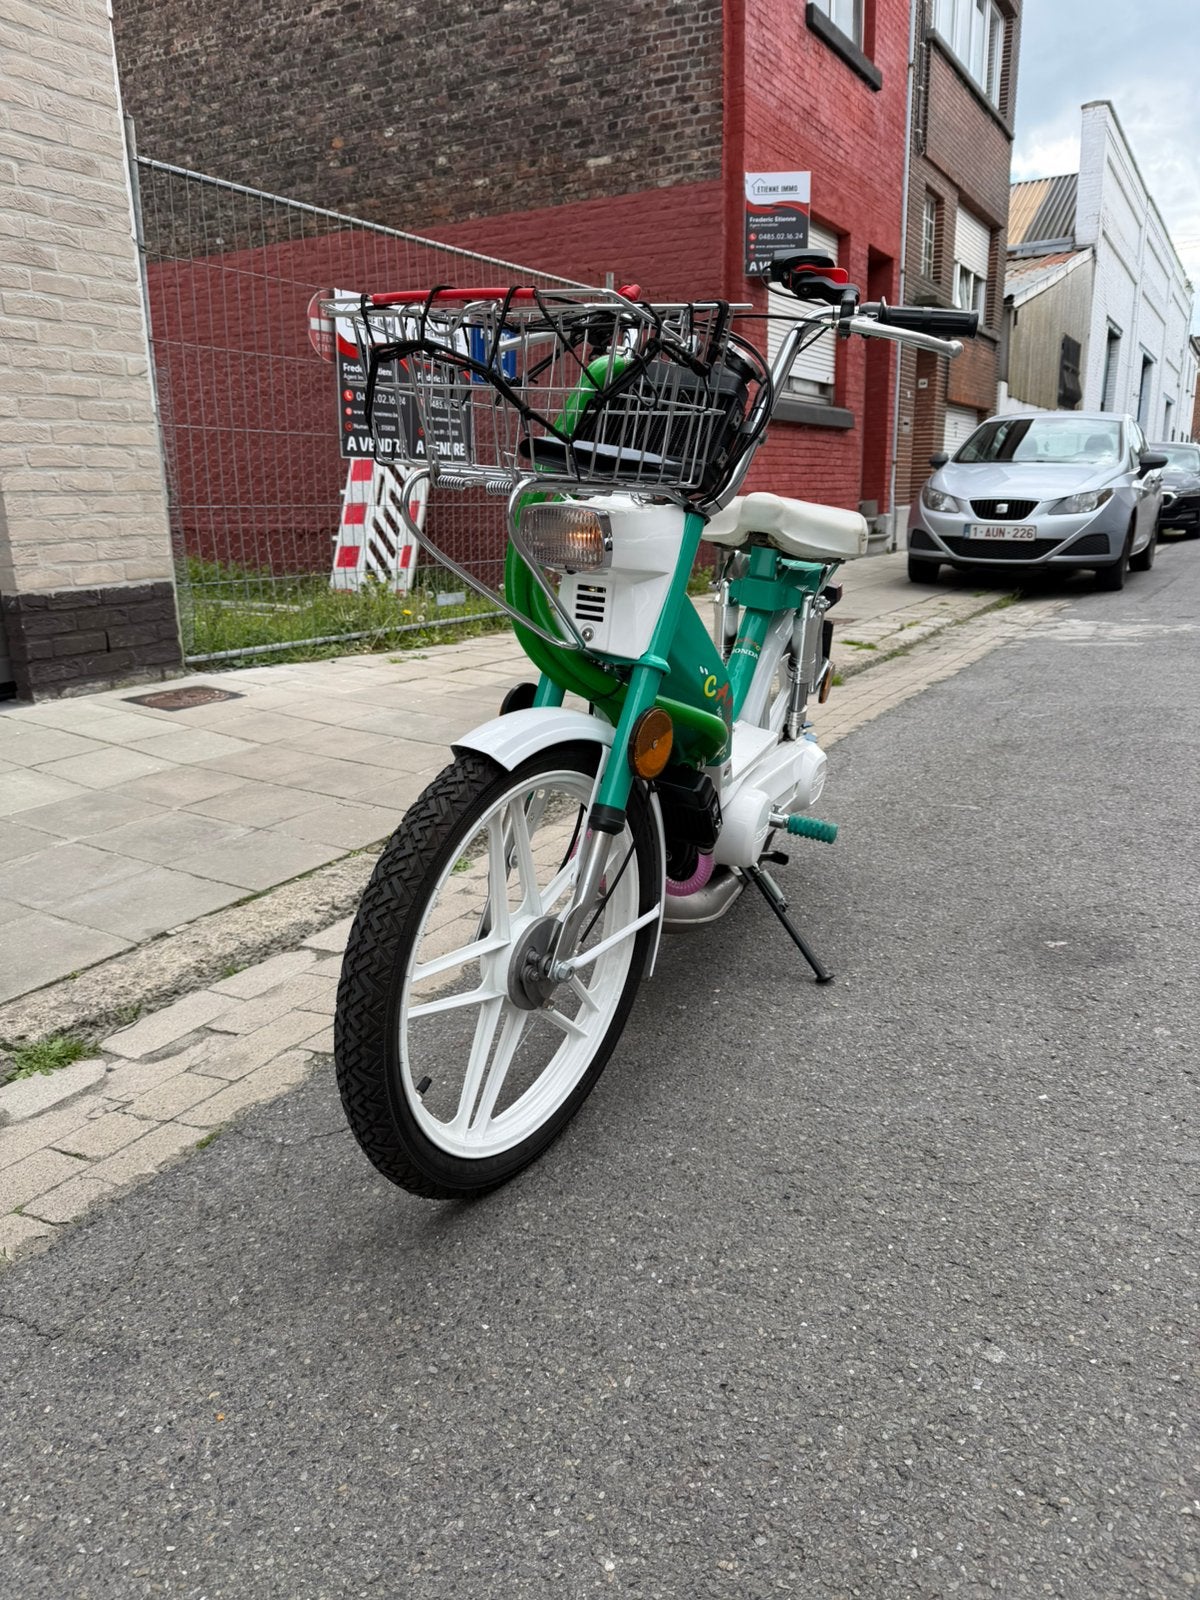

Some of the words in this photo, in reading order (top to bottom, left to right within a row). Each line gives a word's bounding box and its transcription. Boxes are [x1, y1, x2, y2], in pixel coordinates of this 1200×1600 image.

[758, 232, 804, 240] 0485.02.16.24
[749, 261, 758, 272] A
[346, 435, 358, 452] A
[358, 436, 406, 454] VENDR
[415, 439, 425, 455] A
[435, 441, 466, 457] ENDRE
[972, 526, 1034, 539] 1-AUN-226
[731, 647, 759, 660] ONDA
